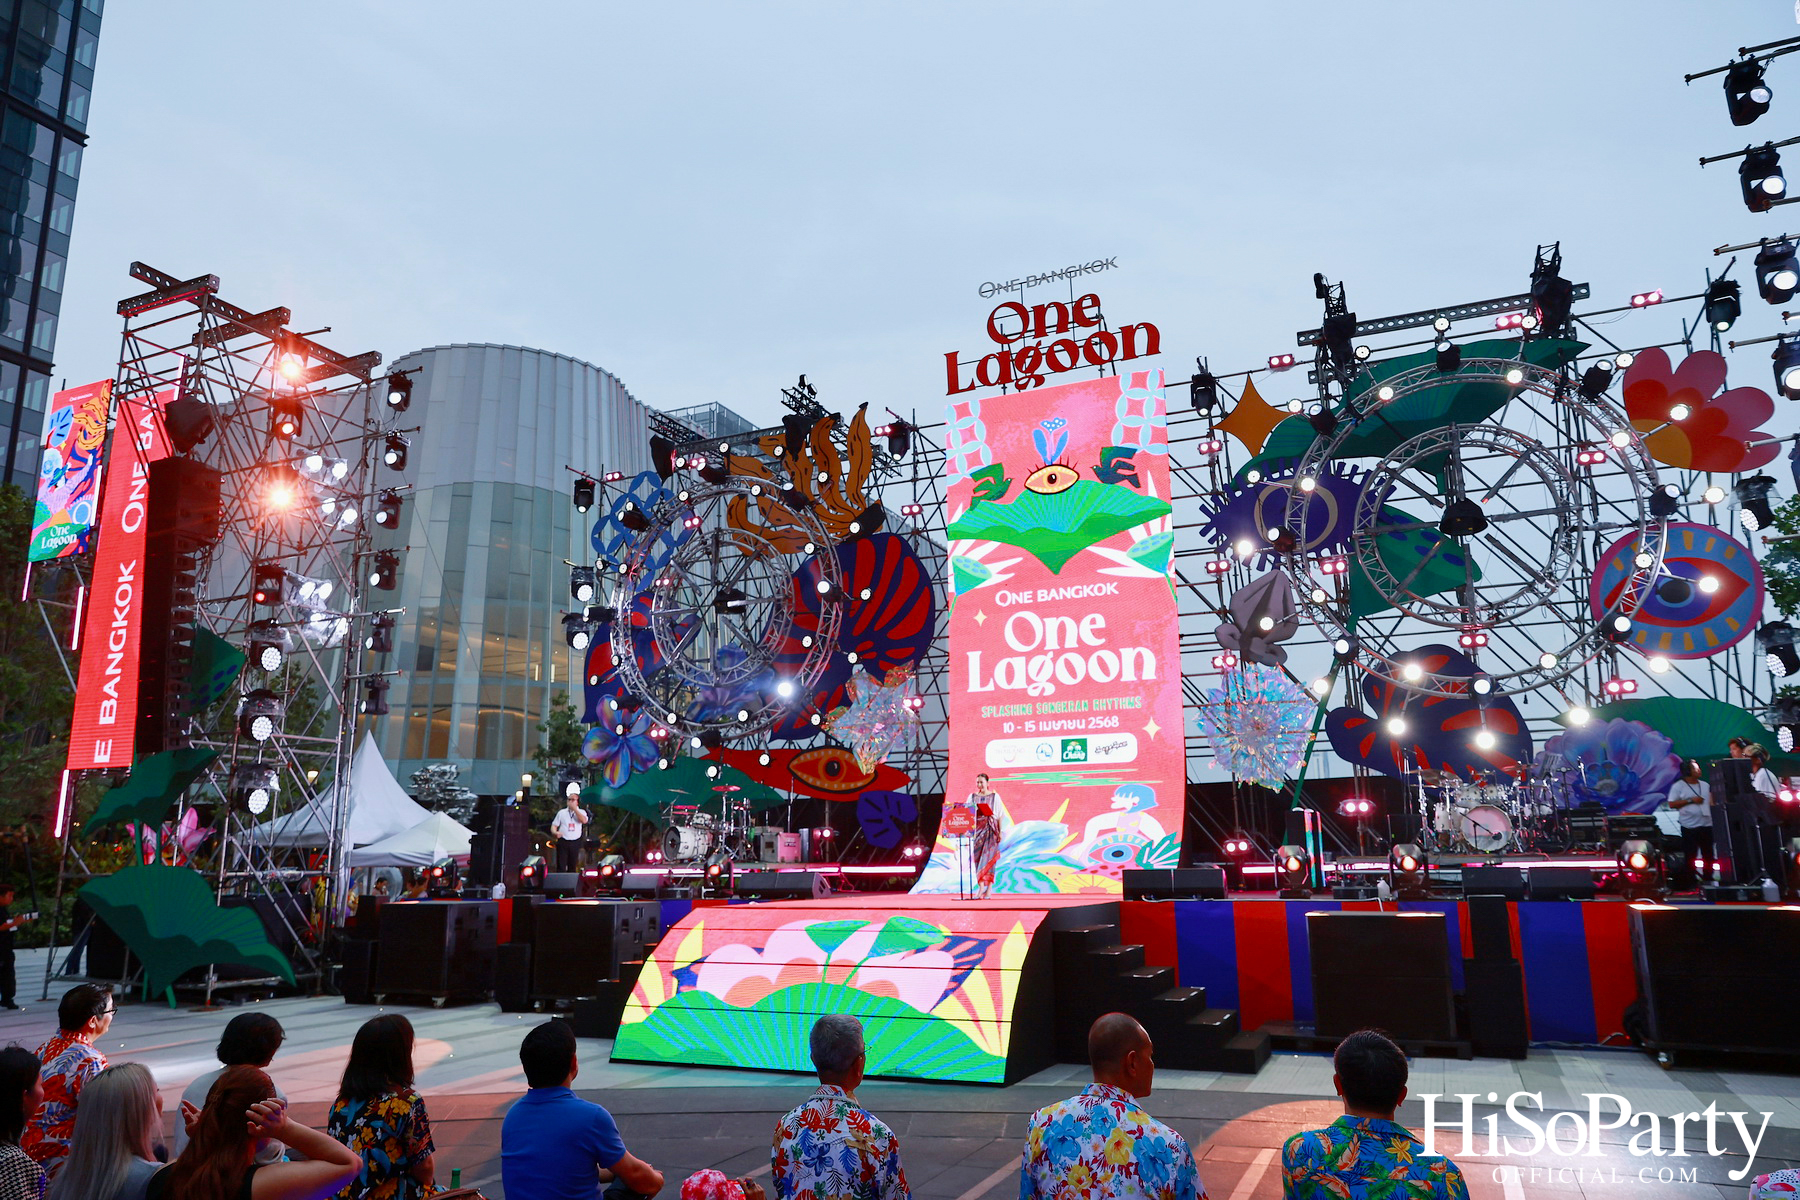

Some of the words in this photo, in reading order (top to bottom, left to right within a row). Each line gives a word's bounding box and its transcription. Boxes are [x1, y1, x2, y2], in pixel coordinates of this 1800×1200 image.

[1026, 256, 1118, 289] BANGKOK
[987, 293, 1101, 344] One
[944, 322, 1161, 395] Lagoon
[41, 534, 77, 549] Lagoon
[50, 525, 70, 537] One
[98, 560, 136, 725] BANGKOK
[122, 462, 149, 533] ONE
[995, 589, 1033, 607] ONE
[1037, 582, 1119, 602] BANGKOK
[1004, 610, 1106, 652] One
[966, 646, 1156, 696] Lagoon
[981, 703, 1032, 718] SPLASHING
[1036, 700, 1089, 715] SONGKRAN
[1093, 696, 1142, 711] RHYTHMS
[1003, 721, 1014, 733] 10
[1024, 720, 1036, 732] 15
[1039, 718, 1085, 731] เมษายน
[1087, 715, 1119, 729] 2568
